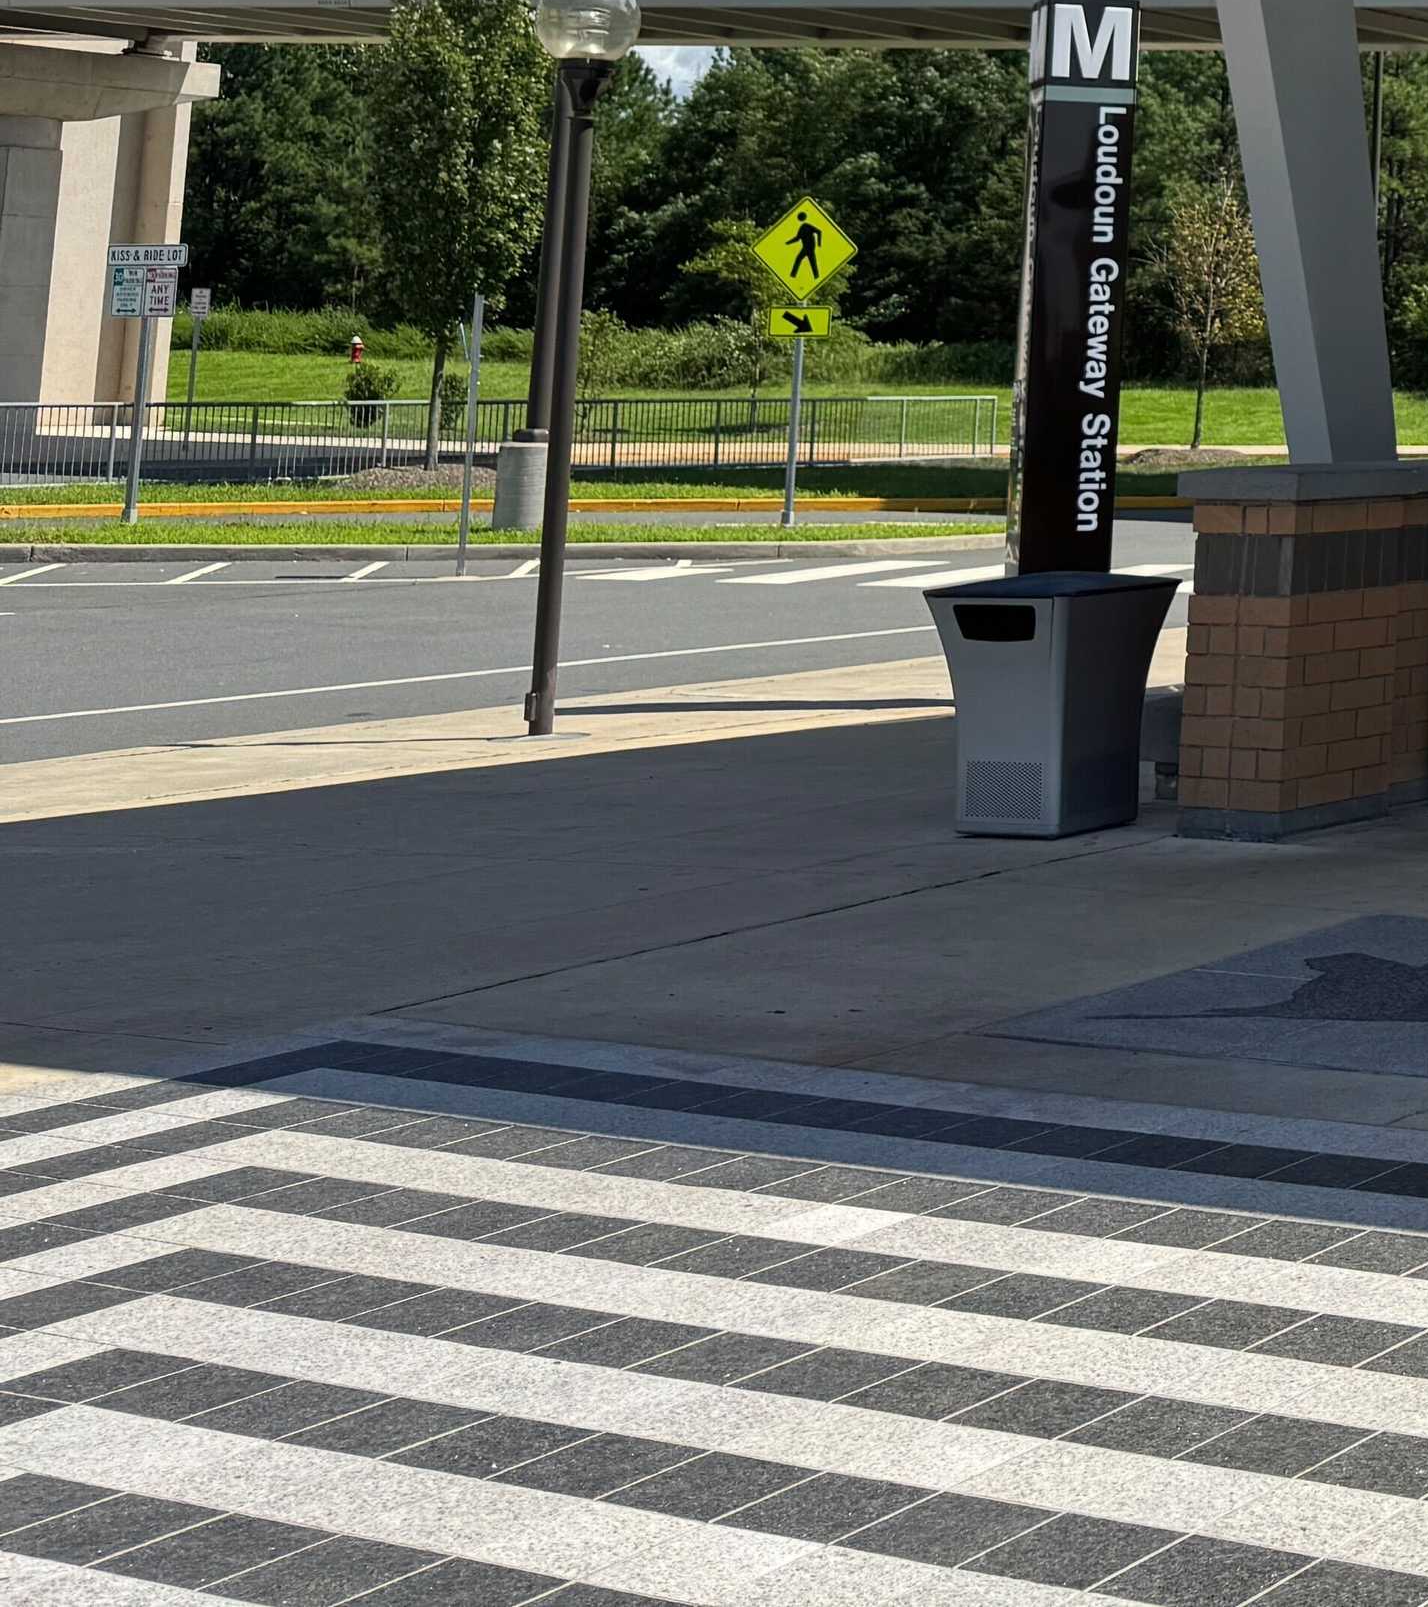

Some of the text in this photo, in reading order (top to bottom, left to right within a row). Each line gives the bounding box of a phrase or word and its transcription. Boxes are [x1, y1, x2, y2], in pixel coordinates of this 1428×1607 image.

[1051, 3, 1133, 81] M
[111, 250, 182, 261] KISS & RIDE LOT
[151, 285, 169, 295] ANY
[149, 296, 169, 305] TIME
[1076, 106, 1128, 532] Loudoun Gateway Station
